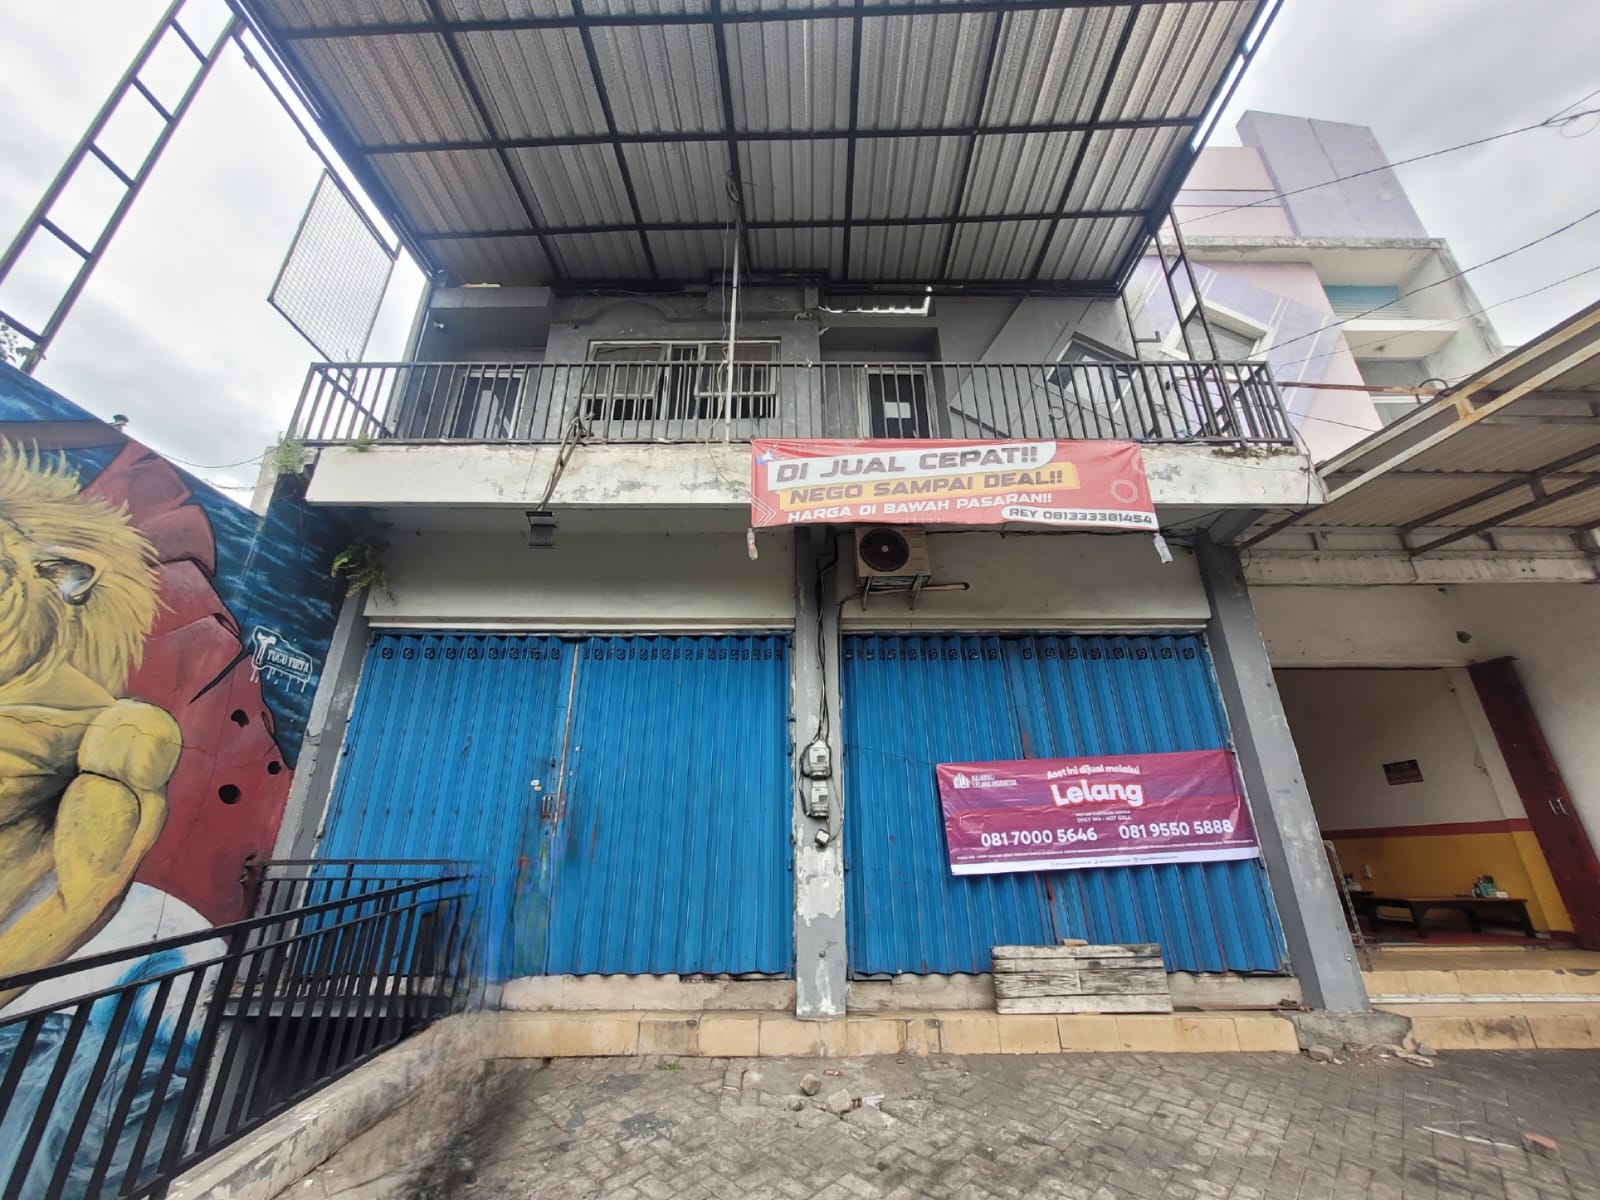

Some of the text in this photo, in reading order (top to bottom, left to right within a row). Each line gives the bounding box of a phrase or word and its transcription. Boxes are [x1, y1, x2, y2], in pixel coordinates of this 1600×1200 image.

[776, 446, 1038, 483] DI JUAL CEPAT!!
[789, 470, 1063, 505] NEGO SAMPAI DEAL!!
[787, 493, 1053, 523] HARGA DI BAWAH PASARAN!!
[1009, 507, 1153, 525] REY 081333381454
[1050, 779, 1144, 807] Lelang
[981, 819, 1234, 847] 081 7000 5646 081 9550 5888
